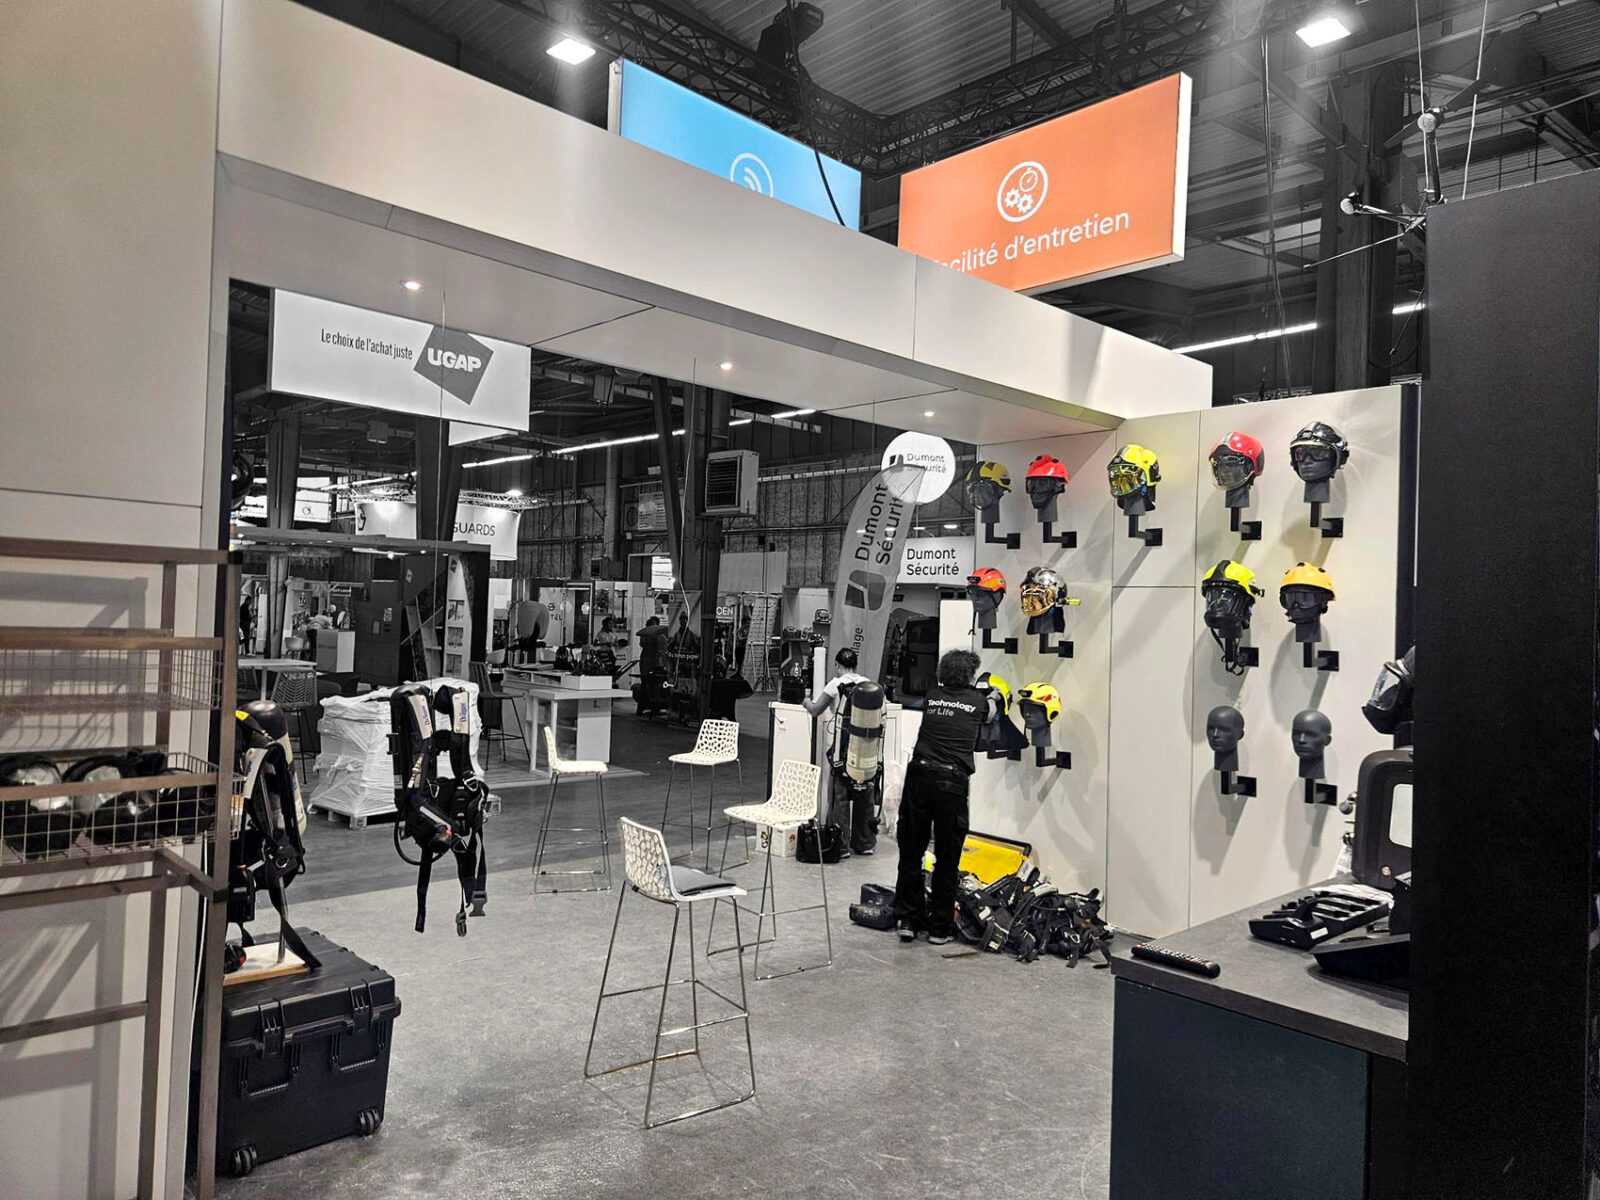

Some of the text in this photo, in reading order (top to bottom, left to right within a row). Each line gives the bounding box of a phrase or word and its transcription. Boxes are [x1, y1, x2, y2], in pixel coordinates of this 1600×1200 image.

[934, 212, 1130, 272] cilité d'entretien
[321, 328, 413, 360] Le choix de l'achat juste
[427, 347, 482, 373] UGAP
[907, 453, 944, 463] Dumont
[854, 484, 889, 561] Dumont
[875, 496, 904, 565] Sécurit
[906, 548, 956, 560] Dumont
[906, 562, 960, 576] Sécurité
[928, 699, 976, 713] Technology
[937, 707, 954, 717] Life
